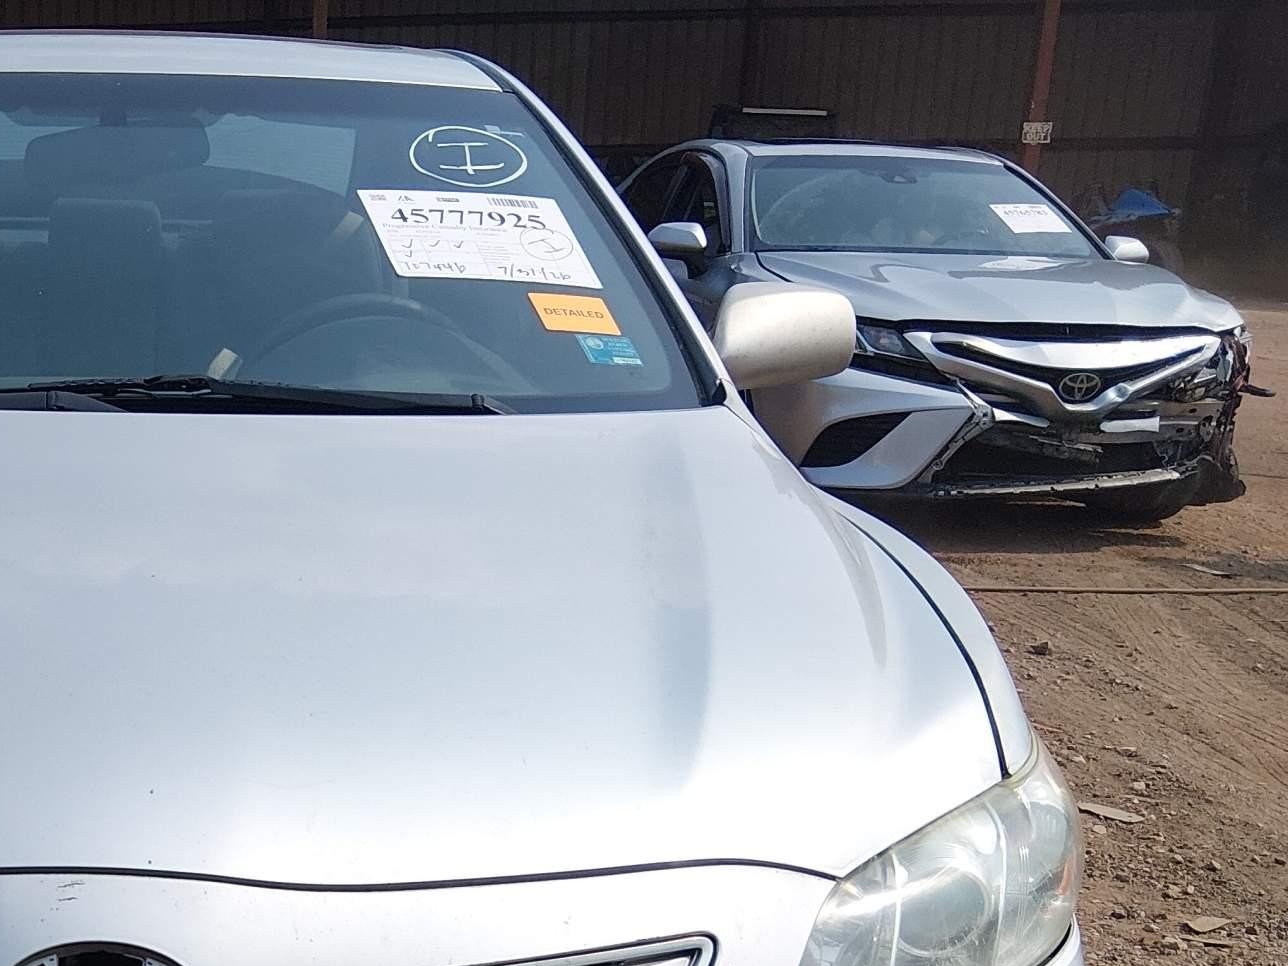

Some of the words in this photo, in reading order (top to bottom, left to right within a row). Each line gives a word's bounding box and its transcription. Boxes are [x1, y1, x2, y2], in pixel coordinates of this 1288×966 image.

[1026, 133, 1046, 141] OUT
[391, 208, 546, 230] 45777925
[543, 307, 605, 319] DETAILED
